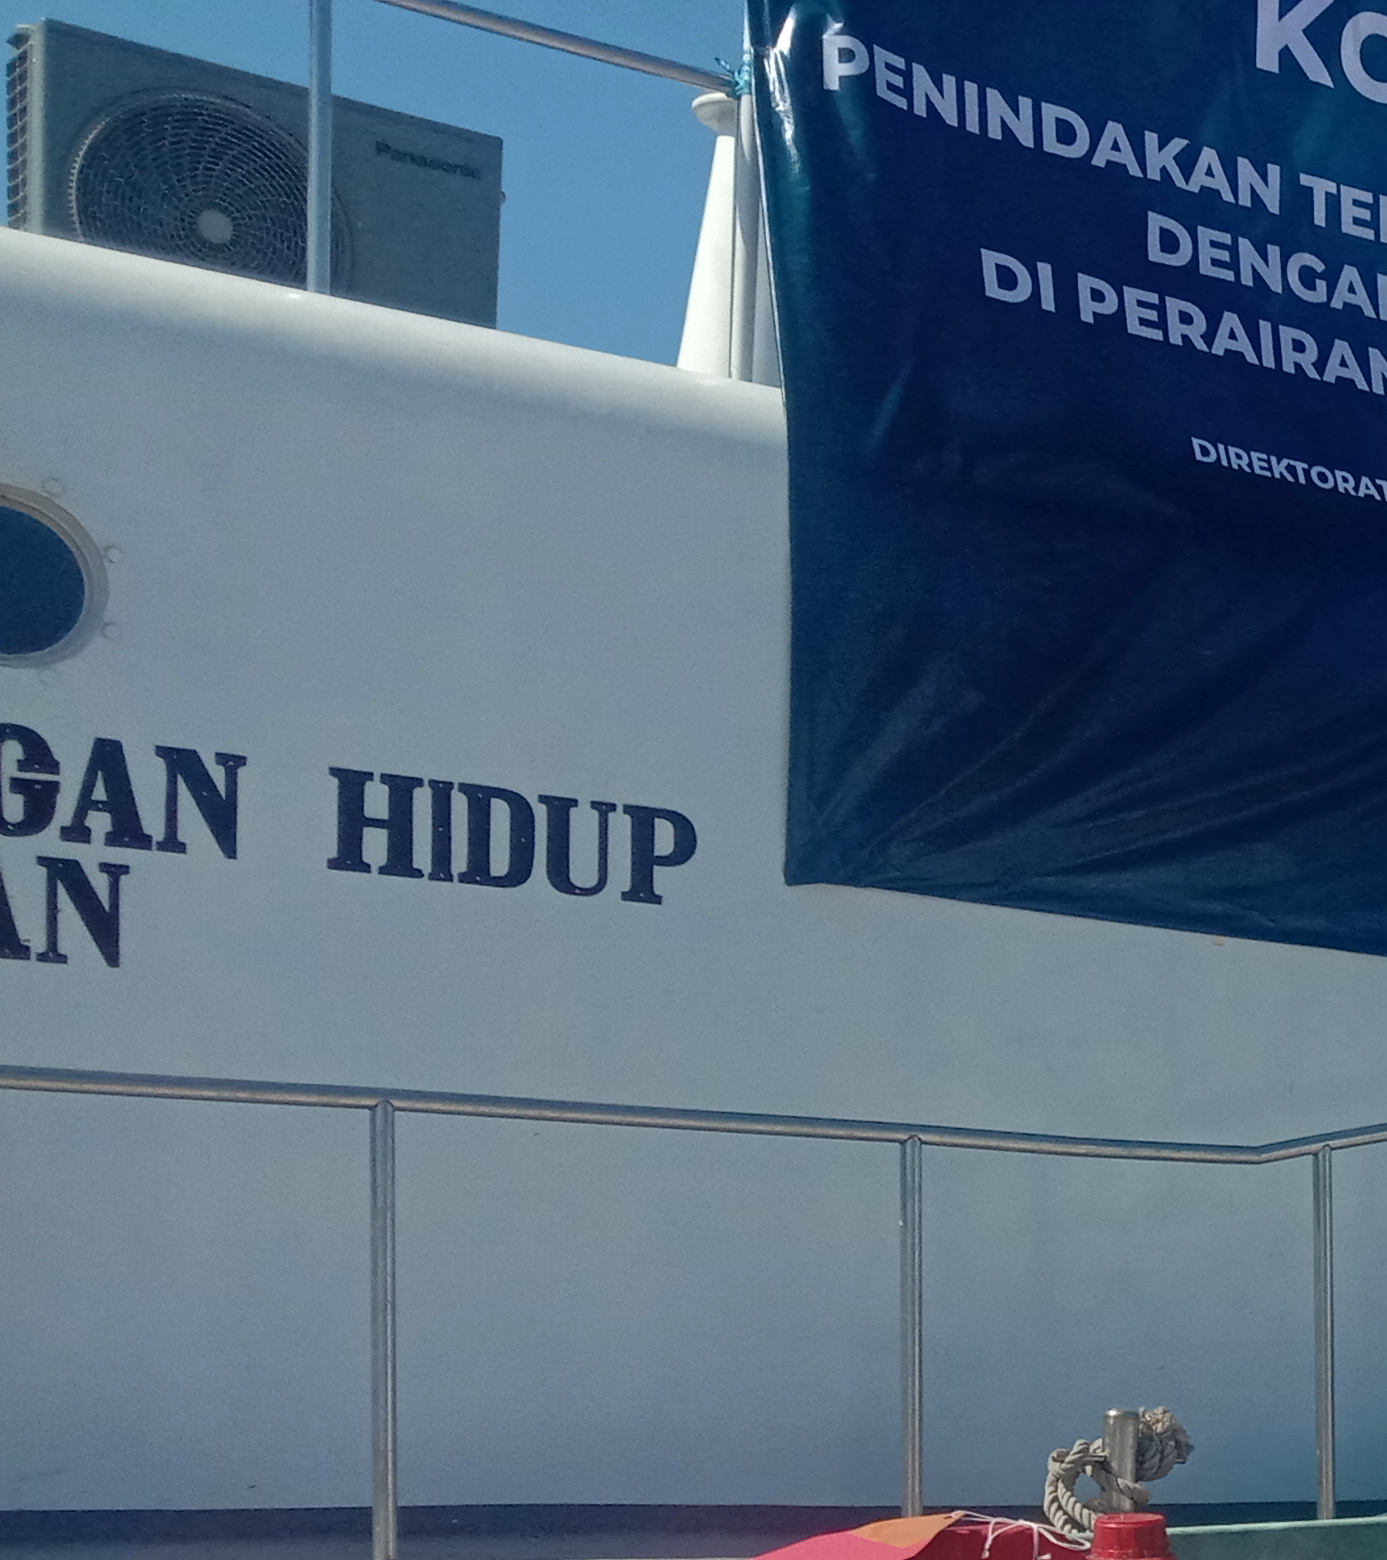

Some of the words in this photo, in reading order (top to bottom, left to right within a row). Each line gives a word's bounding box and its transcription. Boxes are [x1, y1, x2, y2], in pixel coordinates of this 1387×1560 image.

[821, 33, 1281, 215] PENINDAKAN
[981, 248, 1055, 312] DI
[326, 766, 698, 906] HIDUP
